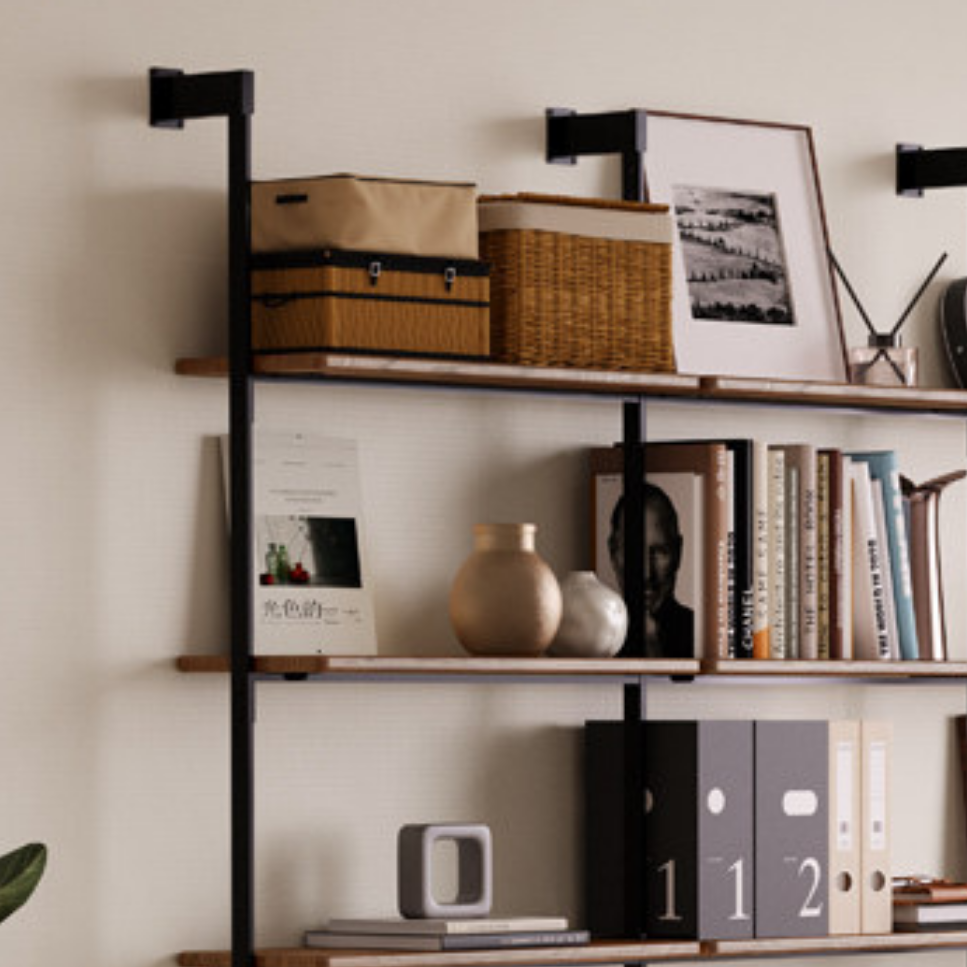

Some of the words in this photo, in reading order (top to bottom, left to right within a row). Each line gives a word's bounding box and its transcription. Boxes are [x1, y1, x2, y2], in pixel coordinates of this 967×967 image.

[739, 585, 754, 651] CHANEL
[657, 859, 683, 921] 1
[726, 857, 751, 921] 1
[797, 857, 824, 918] 2
